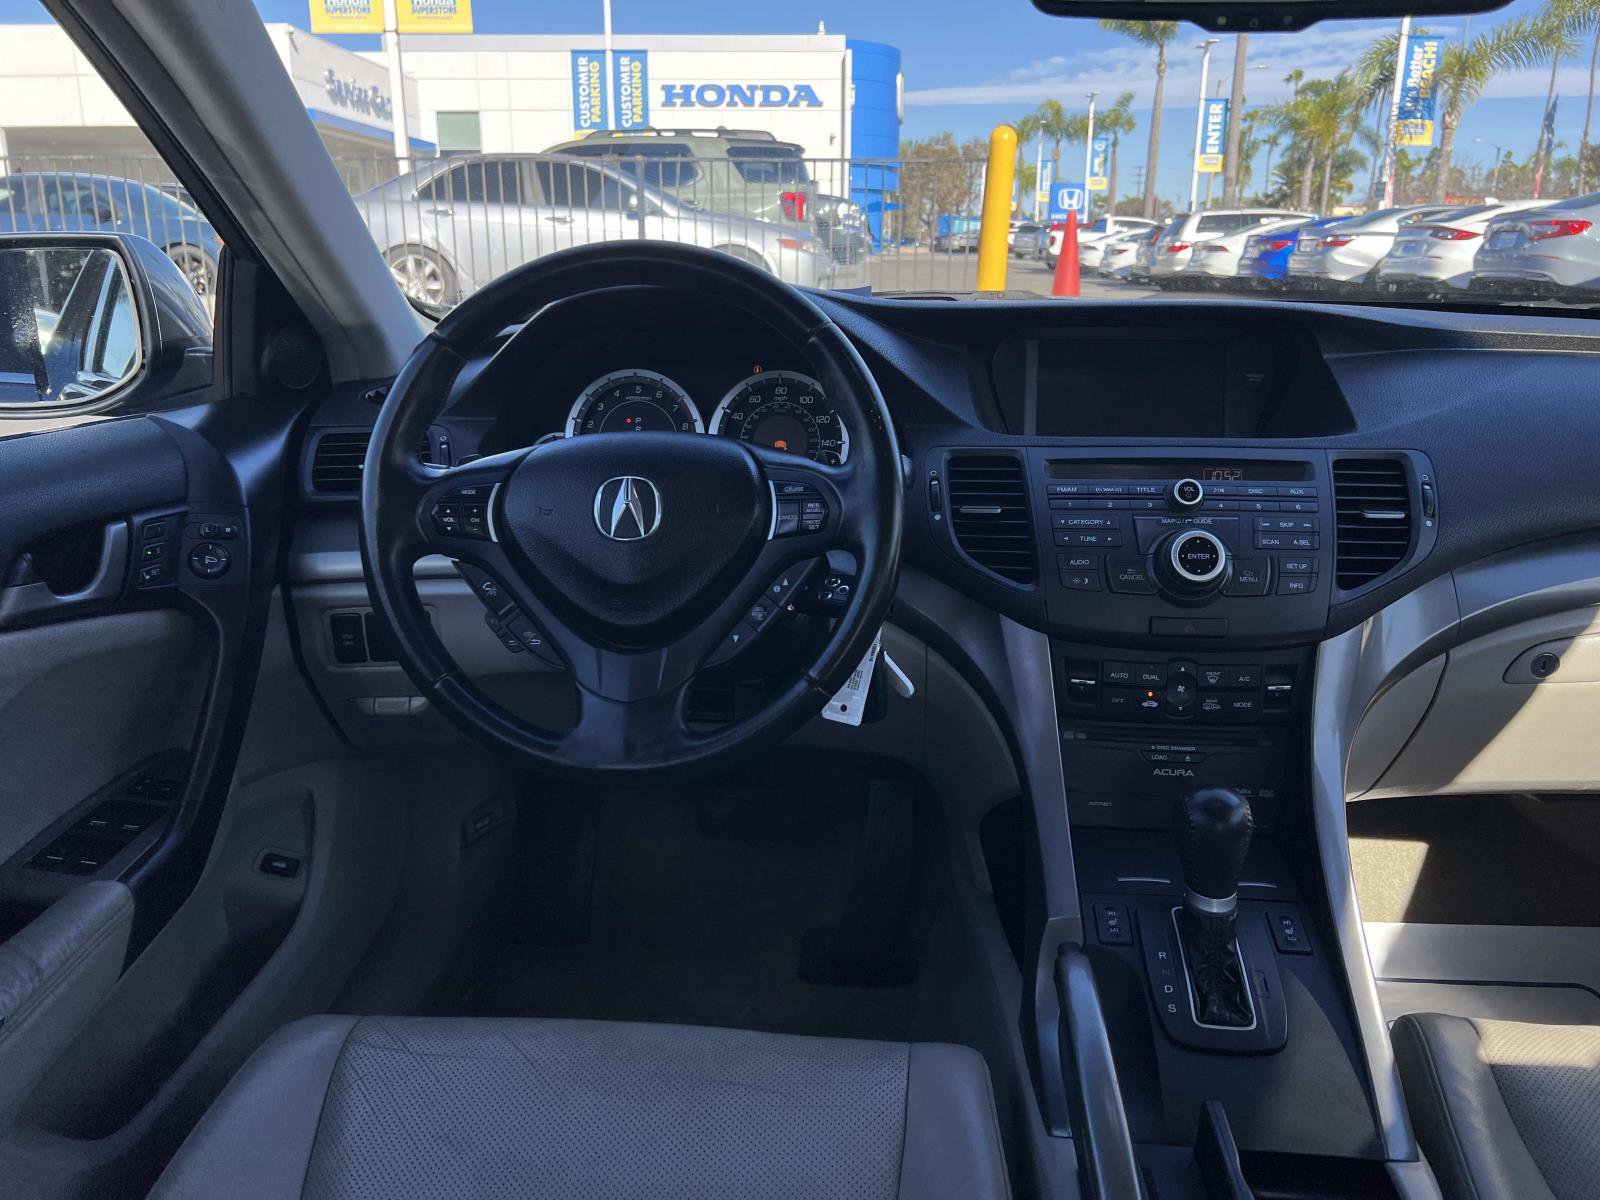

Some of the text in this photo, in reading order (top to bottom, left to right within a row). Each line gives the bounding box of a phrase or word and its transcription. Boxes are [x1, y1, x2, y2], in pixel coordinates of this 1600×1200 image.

[325, 6, 370, 14] SUPERSTORE
[412, 6, 457, 14] SUPERSTORE
[578, 56, 590, 128] CUSTOMER
[590, 60, 602, 123] PARKING
[620, 56, 633, 128] CUSTOMER
[631, 60, 643, 123] PARKING
[660, 83, 824, 108] HONDA
[1206, 103, 1224, 154] ENTER
[614, 390, 620, 398] 4
[636, 386, 641, 394] 5
[656, 390, 662, 399] 6
[775, 386, 788, 395] 80
[749, 395, 761, 404] 60
[800, 396, 814, 404] 100
[598, 402, 604, 411] 3
[732, 412, 744, 421] 40
[815, 415, 831, 424] 120
[587, 420, 594, 429] 2
[682, 422, 689, 431] 8
[820, 439, 836, 448] 140
[1153, 769, 1194, 777] ACURA
[1158, 952, 1167, 960] R
[1164, 985, 1173, 993] D
[1168, 1004, 1176, 1013] S
